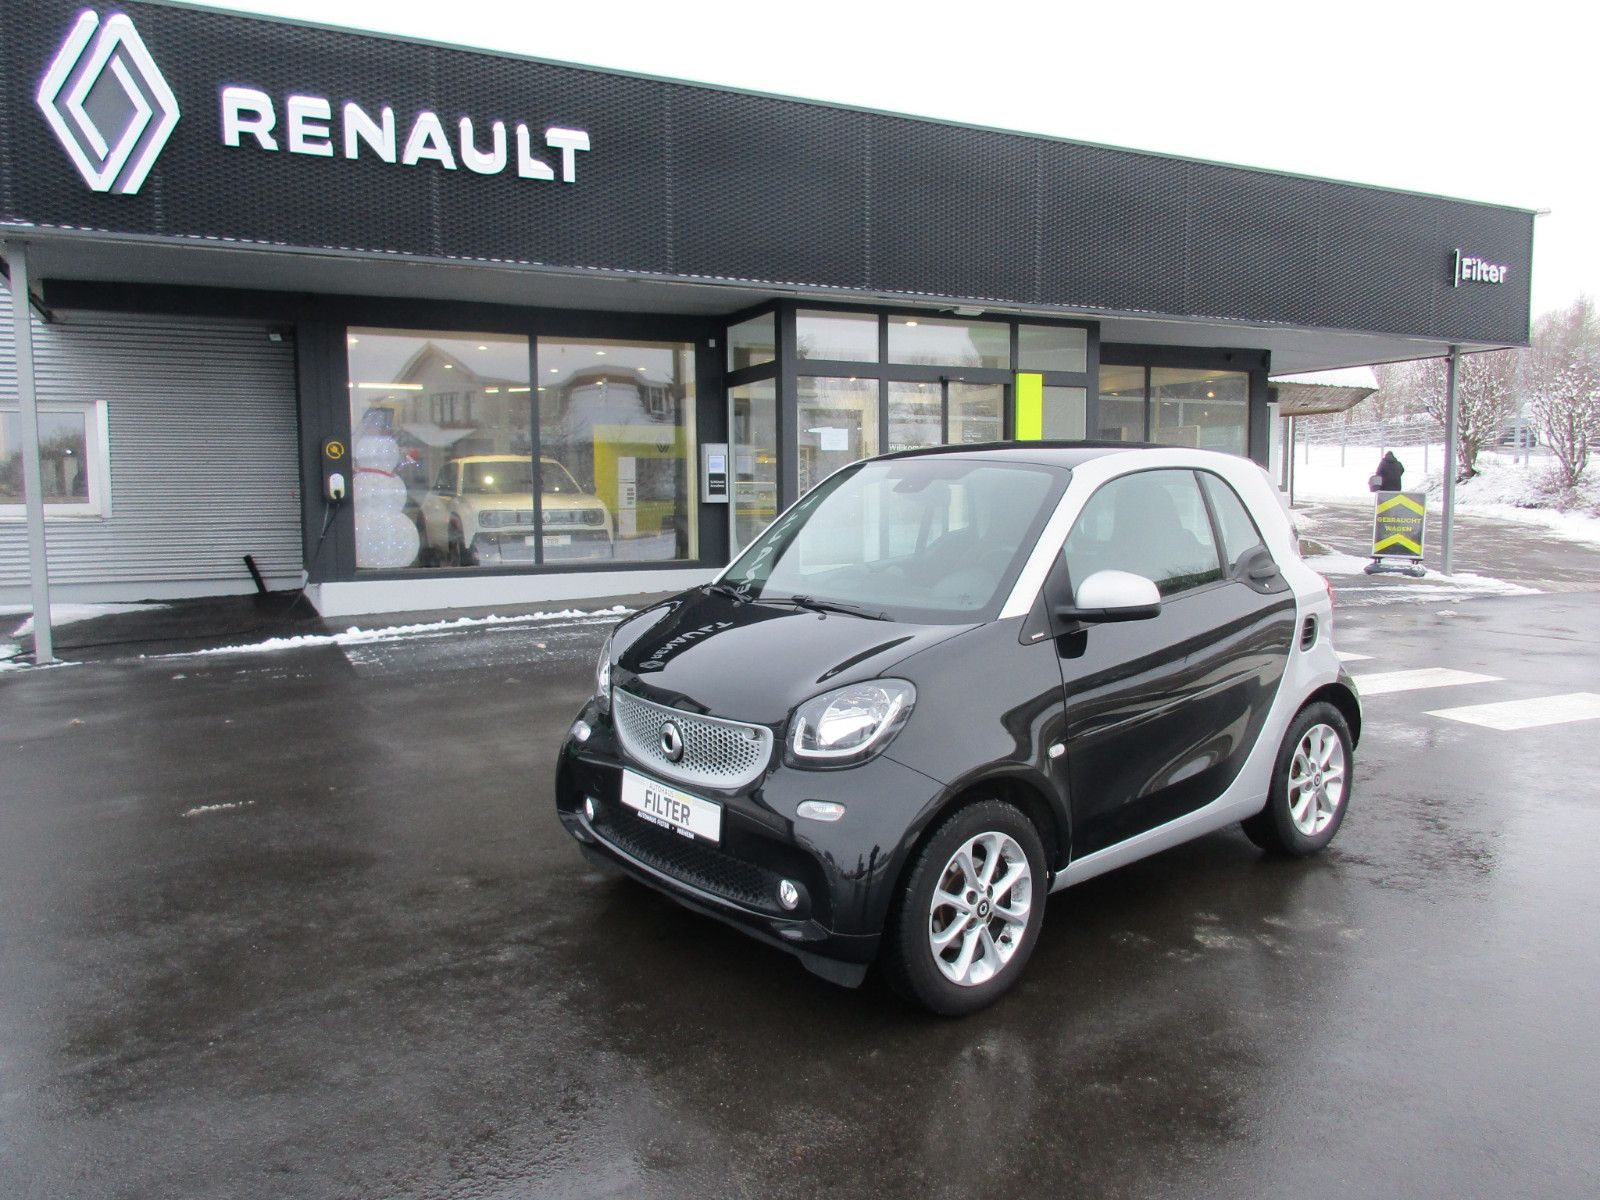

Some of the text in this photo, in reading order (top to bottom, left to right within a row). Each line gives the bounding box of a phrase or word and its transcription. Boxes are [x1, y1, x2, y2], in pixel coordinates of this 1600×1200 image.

[222, 86, 591, 184] RENAULT
[1461, 257, 1507, 284] Filter
[888, 443, 917, 452] Willkom
[1376, 516, 1422, 524] GEBRAUCHT
[1385, 525, 1413, 533] WAGEN
[644, 789, 691, 826] FILTER
